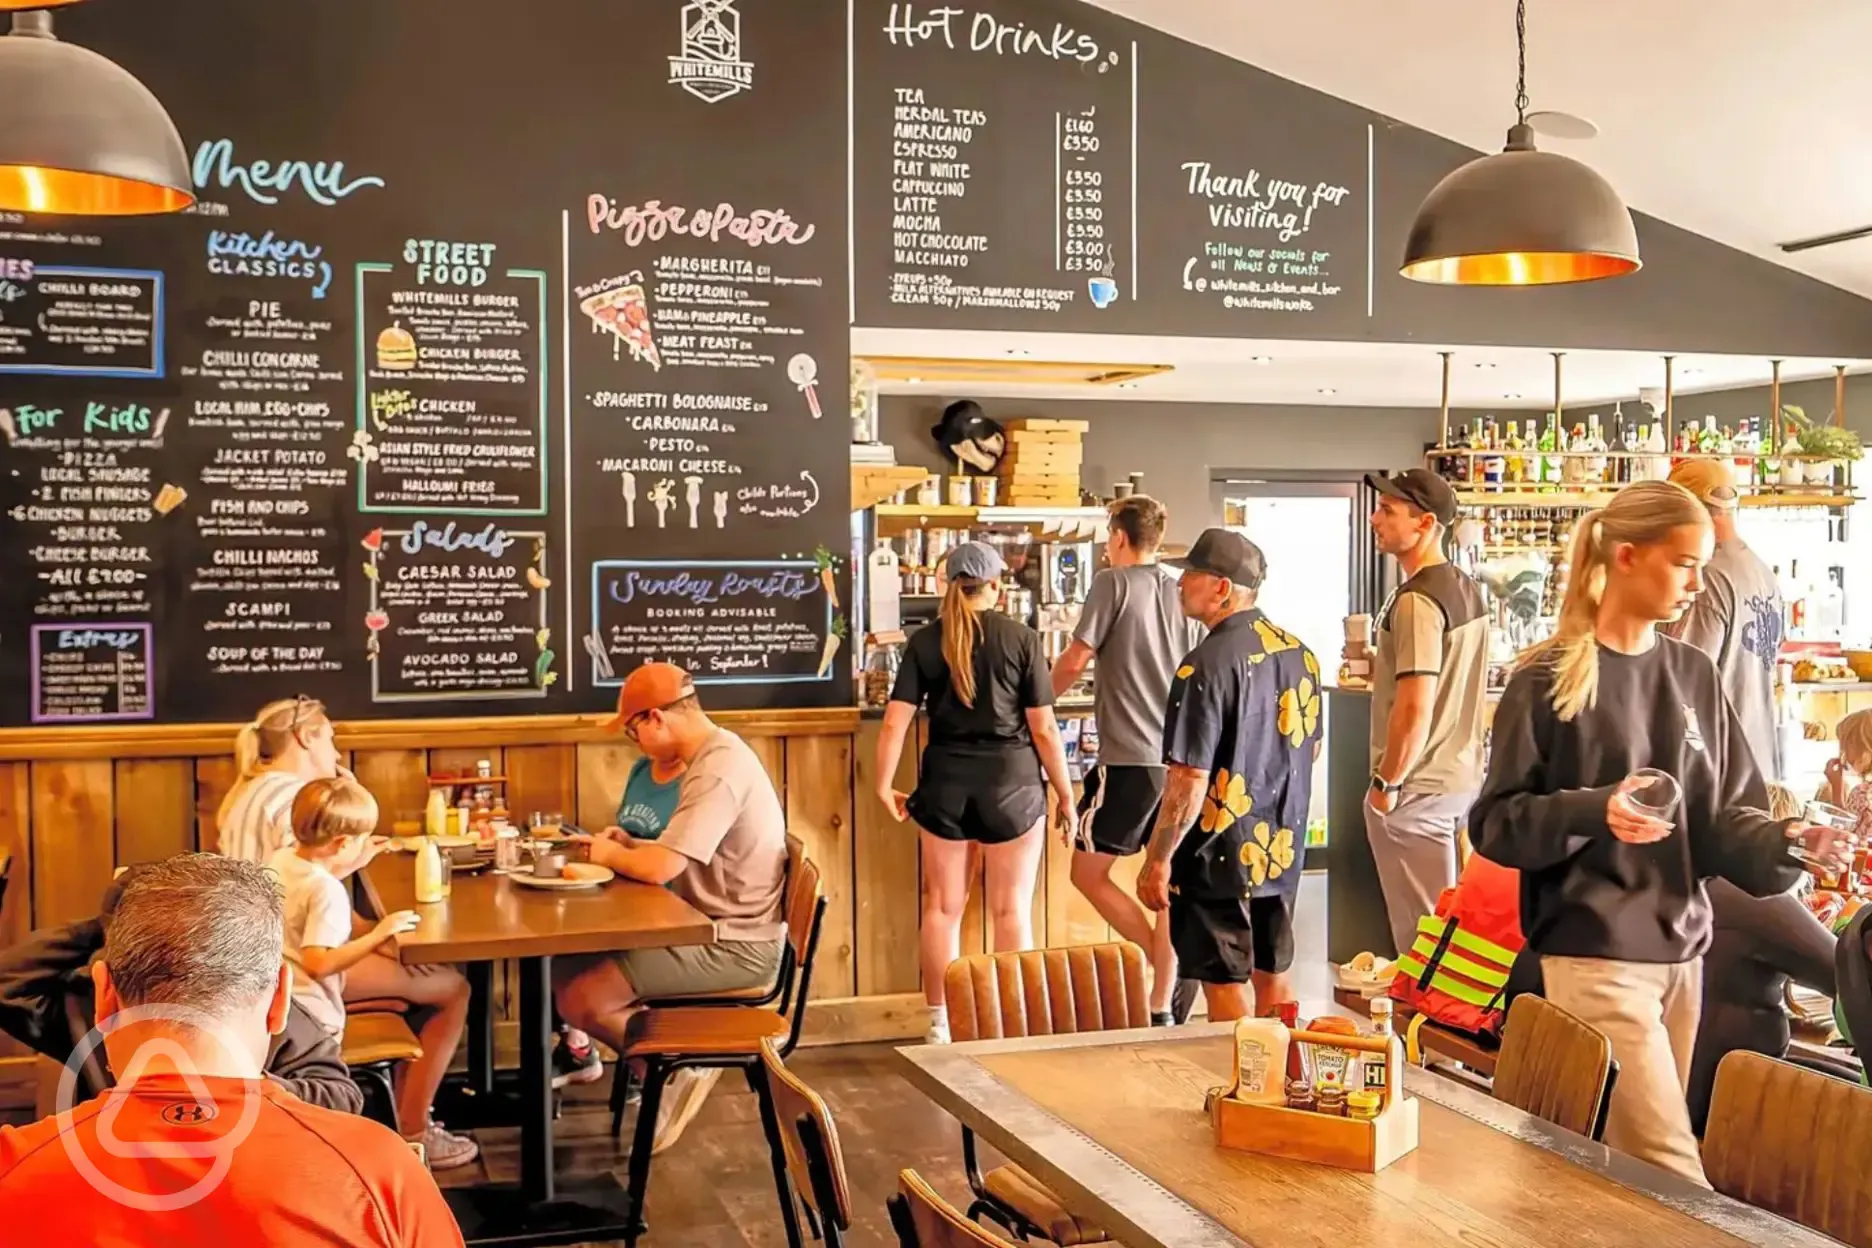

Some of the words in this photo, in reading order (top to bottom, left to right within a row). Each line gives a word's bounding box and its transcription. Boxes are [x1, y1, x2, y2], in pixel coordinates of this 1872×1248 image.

[883, 3, 964, 49] Hot
[970, 11, 1099, 61] Drinks
[669, 61, 753, 85] WHITEMILLS
[894, 88, 925, 105] TEA
[894, 106, 950, 123] HERBAL
[953, 108, 987, 125] TEAS
[893, 122, 973, 143] AMERICANO
[893, 140, 957, 159] ESPRESSO
[192, 138, 384, 205] Menu
[893, 159, 924, 177] FLAT
[929, 162, 971, 179] WHITE
[892, 179, 965, 197] CAPPUCCINO
[1180, 162, 1261, 199] Thank
[1267, 179, 1307, 211] you
[1311, 182, 1350, 210] for
[893, 197, 938, 213] LATTE
[587, 193, 690, 247] Pizza
[709, 203, 816, 247] Pasta
[892, 215, 942, 231] MOCHA
[207, 230, 322, 261] Kitchen
[893, 232, 918, 249] HOT
[919, 235, 989, 252] CHOCOLATE
[403, 238, 496, 267] STREET
[894, 251, 969, 268] MACCHIATO
[1204, 241, 1244, 257] Follow
[1247, 249, 1265, 260] our
[1269, 248, 1306, 263] socials
[1311, 250, 1331, 265] for
[207, 259, 315, 279] CLASSICS
[659, 256, 754, 275] MARGHERITA
[1210, 259, 1227, 272] all
[1233, 259, 1264, 273] News
[416, 263, 487, 287] FOOD
[893, 273, 927, 284] SYRUPS
[89, 283, 142, 298] BOARD
[660, 283, 733, 299] PEPPERONI
[918, 285, 981, 298] ALTERNATIVES
[391, 290, 470, 307] WHITEMILLS
[473, 293, 520, 308] BURGER
[891, 294, 930, 305] CREAM
[962, 296, 1041, 310] MARSHMALLOWS
[248, 300, 282, 318] PIE
[657, 309, 685, 322] HAM
[690, 311, 752, 326] PINEAPPLE
[662, 335, 696, 348] MEAT
[699, 336, 739, 350] FEAST
[202, 350, 250, 367] CHILLI
[251, 352, 279, 368] CON
[280, 353, 320, 368] CARNE
[418, 346, 471, 361] CHICKEN
[473, 348, 522, 362] BURGER
[194, 400, 233, 416] LOCAL
[418, 398, 477, 413] CHICKEN
[592, 391, 667, 410] SPAGHETTI
[672, 392, 753, 412] BOLOGNAISE
[15, 404, 63, 434] For
[84, 401, 151, 433] Kids
[631, 415, 720, 432] CARBONARA
[379, 442, 411, 456] ASIAN
[411, 443, 441, 456] STYLE
[442, 444, 471, 457] FRIED
[472, 444, 536, 458] CAULIFLOWER
[649, 438, 695, 452] PESTO
[63, 452, 118, 467] PIZZA
[213, 449, 271, 464] JACKET
[274, 449, 327, 465] POTATO
[601, 458, 674, 473] MACARONI
[678, 458, 728, 474] CHEESE
[40, 467, 83, 482] LOCAL
[88, 468, 151, 482] SAUSAGE
[402, 478, 459, 492] HALLOUMI
[461, 480, 496, 493] FRIES
[27, 507, 84, 521] CHICKEN
[88, 507, 153, 522] NUGGETS
[210, 500, 245, 515] FISH
[247, 500, 274, 515] AND
[275, 500, 310, 515] CHIPS
[56, 525, 122, 542] BURGER
[401, 520, 515, 558] Salads
[35, 546, 86, 562] CHEESE
[90, 547, 152, 562] BURGER
[212, 550, 264, 566] CHILLI
[266, 550, 320, 565] NACHOS
[397, 565, 462, 581] CAESAR
[466, 565, 517, 579] SALAD
[610, 571, 719, 604] Sunday
[719, 570, 820, 600] Roasts
[224, 602, 291, 617] SCAMPI
[417, 612, 460, 625] GREEK
[461, 610, 504, 624] SALAD
[646, 607, 705, 619] BOOKING
[710, 607, 777, 618] ADVISABLE
[206, 646, 248, 661] SOUP
[250, 648, 268, 661] OF
[271, 647, 296, 660] THE
[298, 647, 325, 660] DAY
[402, 652, 470, 666] AVOCADO
[475, 652, 519, 665] SALAD
[1317, 1053, 1345, 1064] TOMATO
